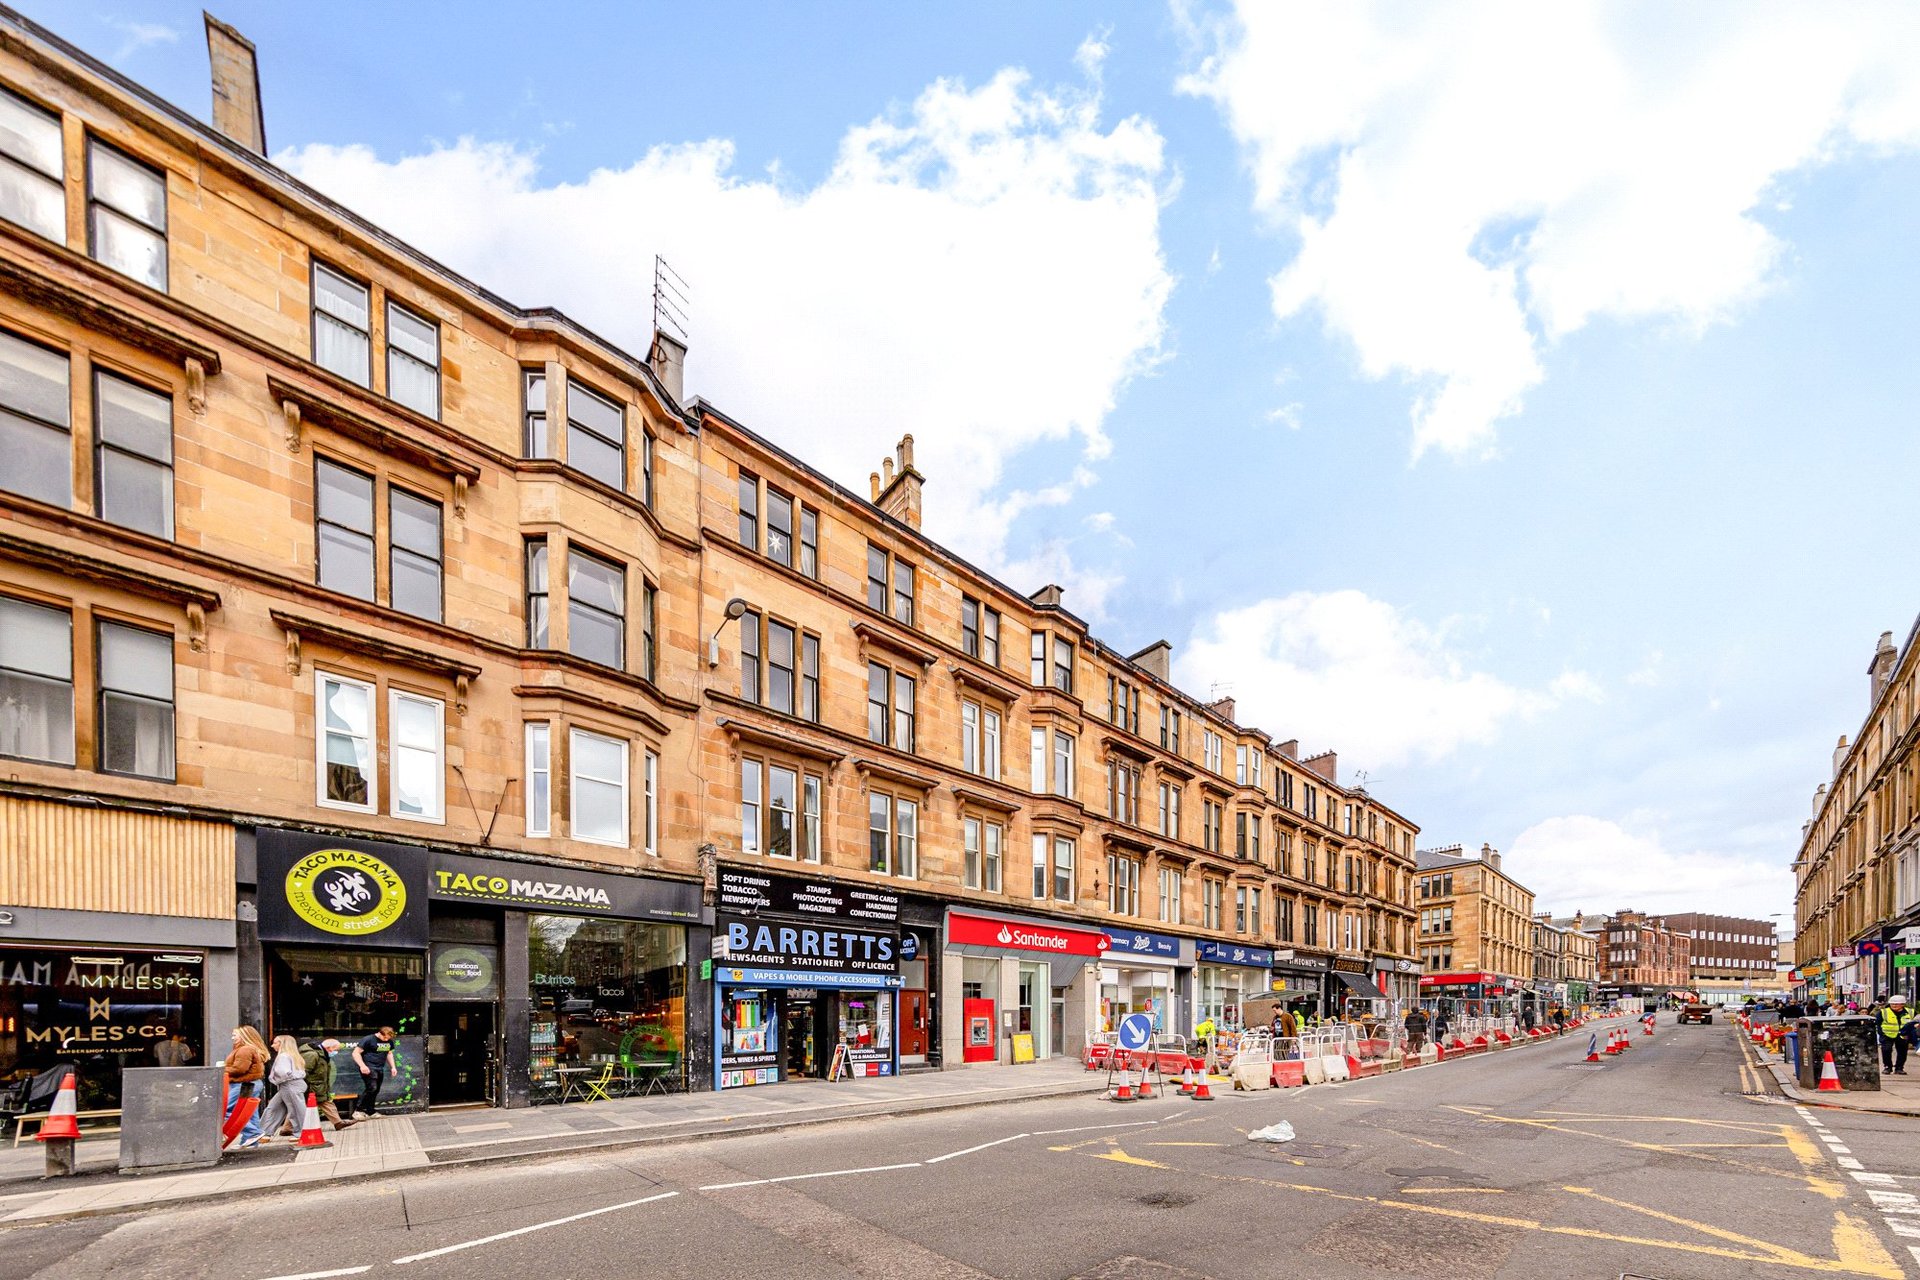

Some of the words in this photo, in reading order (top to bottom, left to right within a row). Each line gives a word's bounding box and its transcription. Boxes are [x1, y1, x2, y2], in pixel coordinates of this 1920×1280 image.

[294, 855, 328, 879] TACO
[331, 852, 397, 889] MAZAMA
[723, 874, 742, 884] SOFT
[743, 877, 771, 887] DRINKS
[435, 870, 509, 893] TACO
[511, 879, 611, 905] MAZAMA
[722, 884, 757, 895] TOBACCO
[806, 885, 832, 895] STAMPS
[722, 894, 771, 907] NEWSPAPERS
[793, 893, 843, 906] PHOTOCOPYING
[850, 891, 879, 901] GREETING
[879, 895, 898, 904] CARDS
[294, 891, 340, 928] mexican
[343, 916, 384, 930] street
[379, 898, 398, 919] food
[799, 903, 837, 914] MAGAZINES
[866, 902, 898, 912] HARDWARE
[850, 909, 897, 921] CONFECTIONARY
[728, 922, 893, 961] BARRETTS
[902, 939, 913, 947] OFF
[1013, 930, 1068, 949] Santander
[792, 957, 844, 968] STATIONERY
[852, 961, 866, 969] OFF
[867, 962, 895, 971] LICENCE
[1336, 960, 1365, 973] ESPRESSO
[82, 974, 163, 990] MYLES
[534, 973, 576, 985] Burritos
[753, 972, 778, 981] VAPES
[786, 974, 814, 982] MOBILE
[814, 975, 838, 983] PHONE
[839, 976, 881, 984] ACCESSORIES
[597, 984, 625, 996] Tacos
[26, 1026, 124, 1043] MYLES
